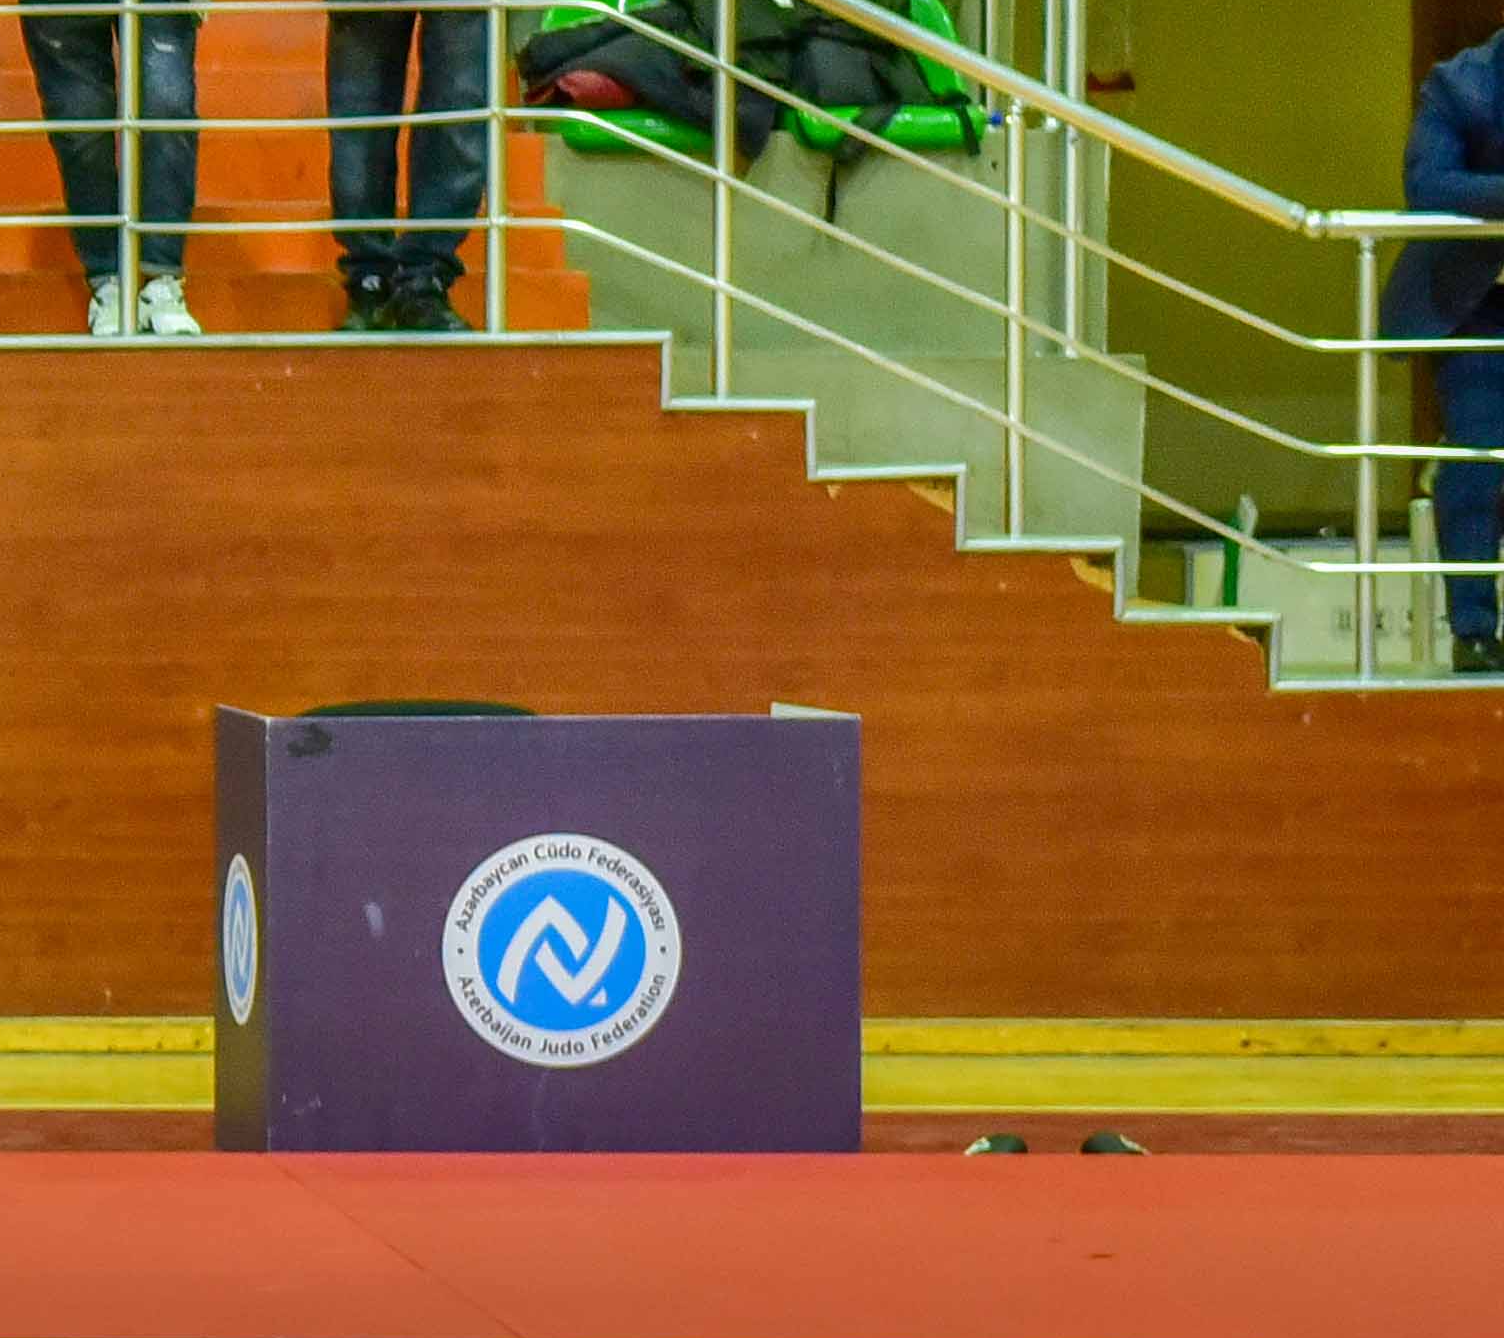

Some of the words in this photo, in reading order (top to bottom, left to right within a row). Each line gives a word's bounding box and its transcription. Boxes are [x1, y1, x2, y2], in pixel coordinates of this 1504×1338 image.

[533, 841, 582, 861] Cüdo
[588, 847, 665, 931] Federasiyası
[458, 976, 532, 1050] Azerbaijan
[539, 1038, 584, 1056] Judo
[591, 974, 666, 1050] Federation
